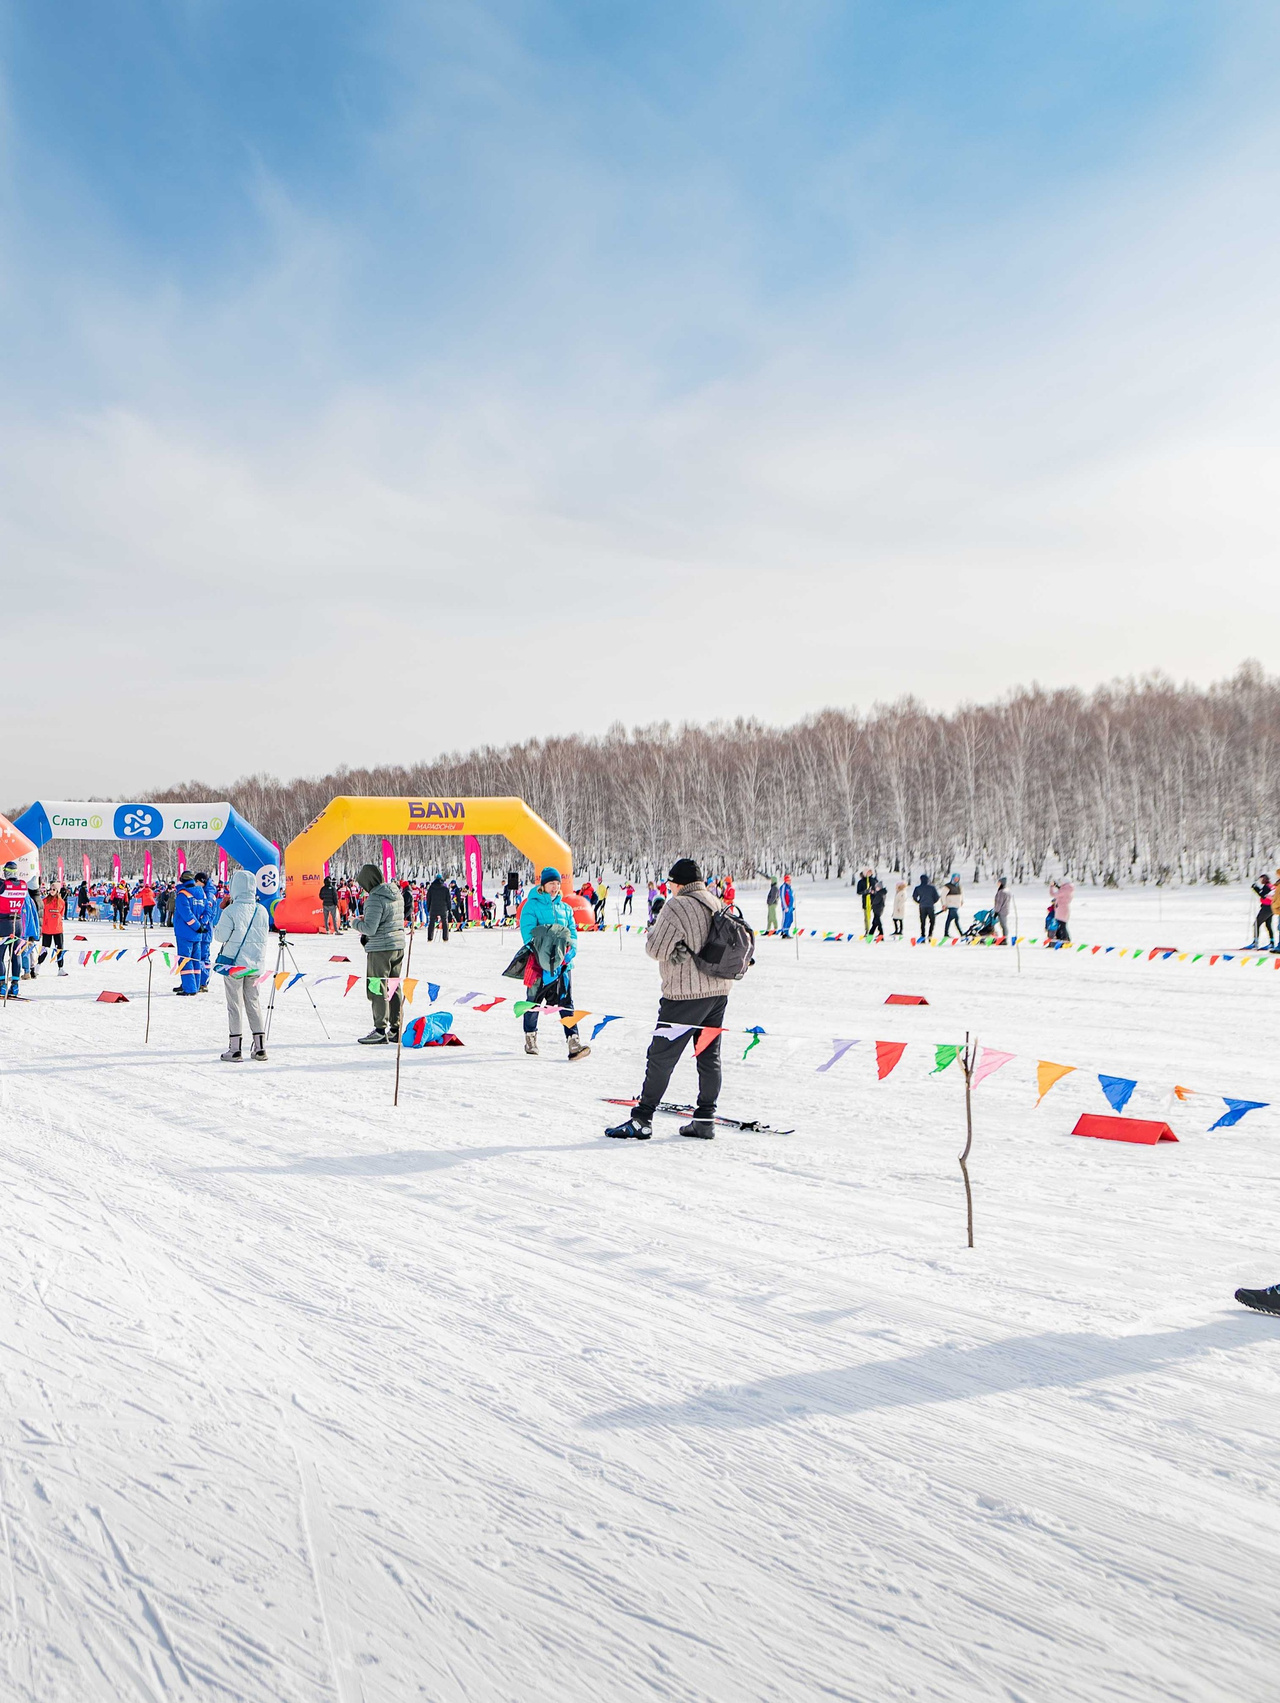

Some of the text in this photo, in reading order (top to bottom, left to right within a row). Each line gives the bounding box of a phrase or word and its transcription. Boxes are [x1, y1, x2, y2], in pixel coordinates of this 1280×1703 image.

[408, 802, 465, 818] БАМ
[52, 815, 88, 827] Слата
[173, 819, 208, 830] Слата
[9, 900, 22, 908] 114
